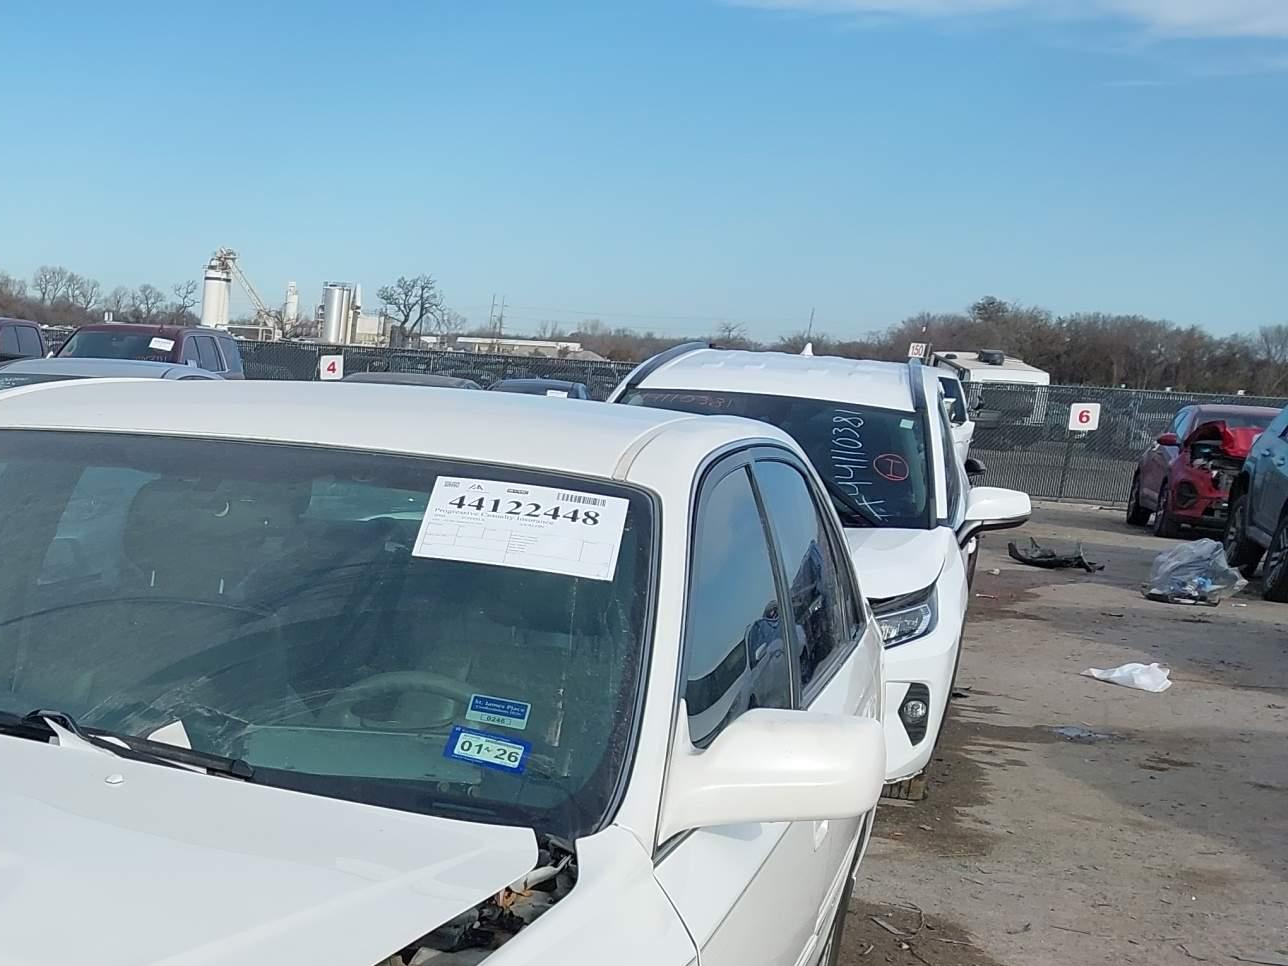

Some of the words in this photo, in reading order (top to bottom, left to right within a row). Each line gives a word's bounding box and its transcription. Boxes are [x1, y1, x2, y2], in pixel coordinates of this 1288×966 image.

[911, 344, 924, 356] 150
[326, 360, 337, 374] 4
[1078, 409, 1091, 424] 6
[434, 507, 479, 518] Progressive
[481, 511, 513, 522] Casualty
[516, 516, 554, 526] Insurance
[448, 495, 601, 527] 44122448
[460, 740, 484, 755] 01
[494, 748, 520, 763] 26
